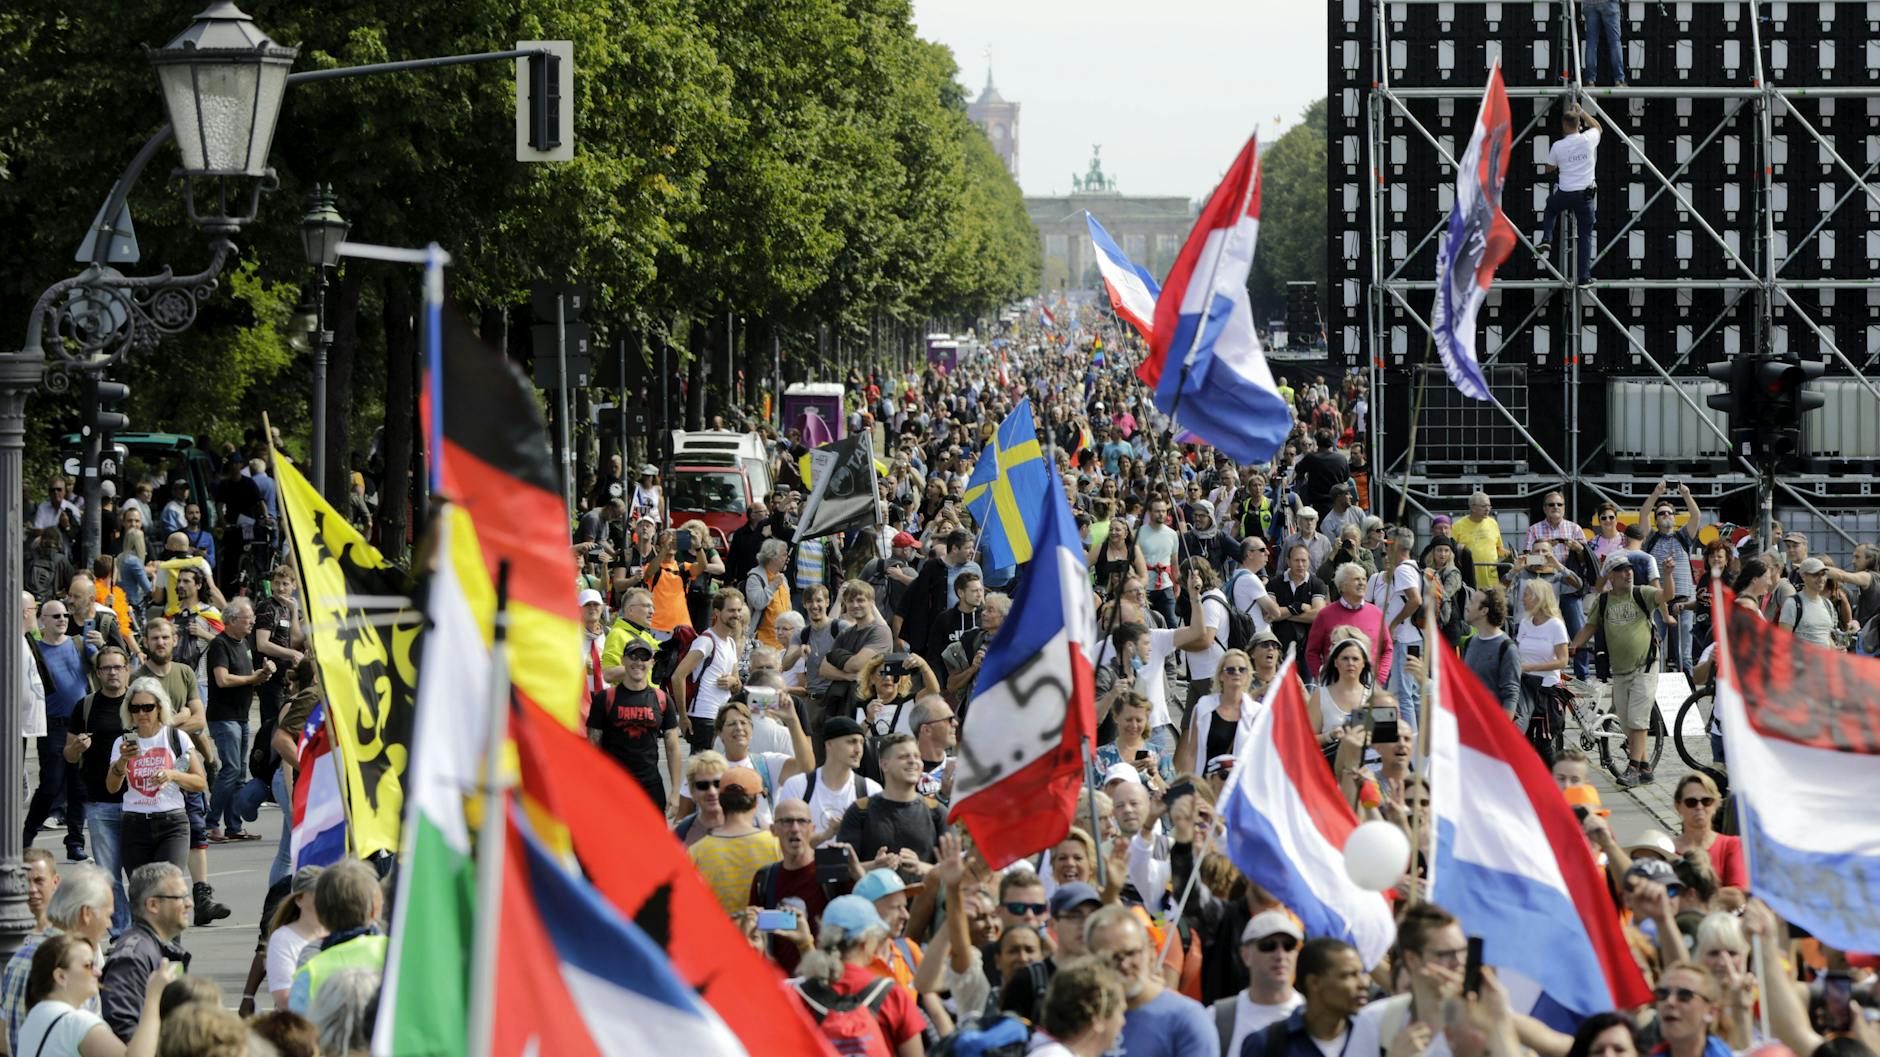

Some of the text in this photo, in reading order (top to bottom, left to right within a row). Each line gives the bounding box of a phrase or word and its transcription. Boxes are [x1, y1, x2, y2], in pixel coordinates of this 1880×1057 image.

[1568, 152, 1588, 162] CREW
[617, 706, 655, 721] DANZIG
[134, 756, 165, 767] FRIEDEN
